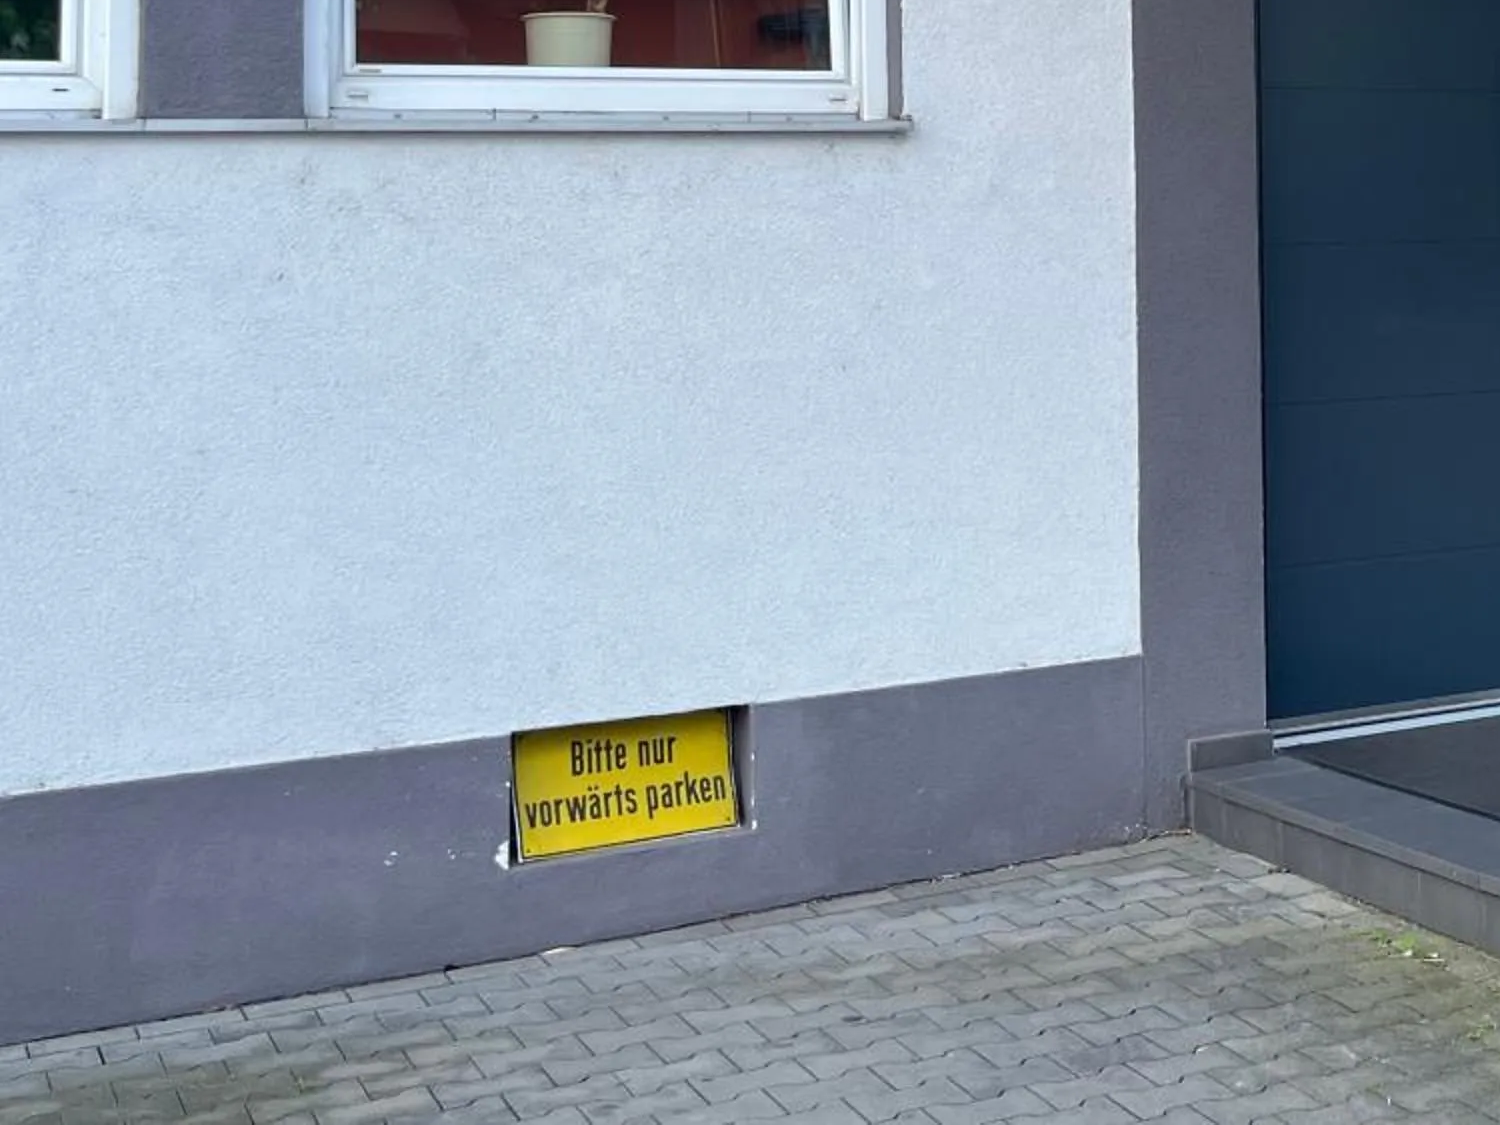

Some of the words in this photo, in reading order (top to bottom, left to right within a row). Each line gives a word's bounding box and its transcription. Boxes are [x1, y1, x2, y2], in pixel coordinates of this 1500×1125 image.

[570, 738, 628, 776] Bitte
[638, 736, 677, 767] nur
[525, 783, 638, 828] vorwärts
[645, 771, 726, 819] parken
